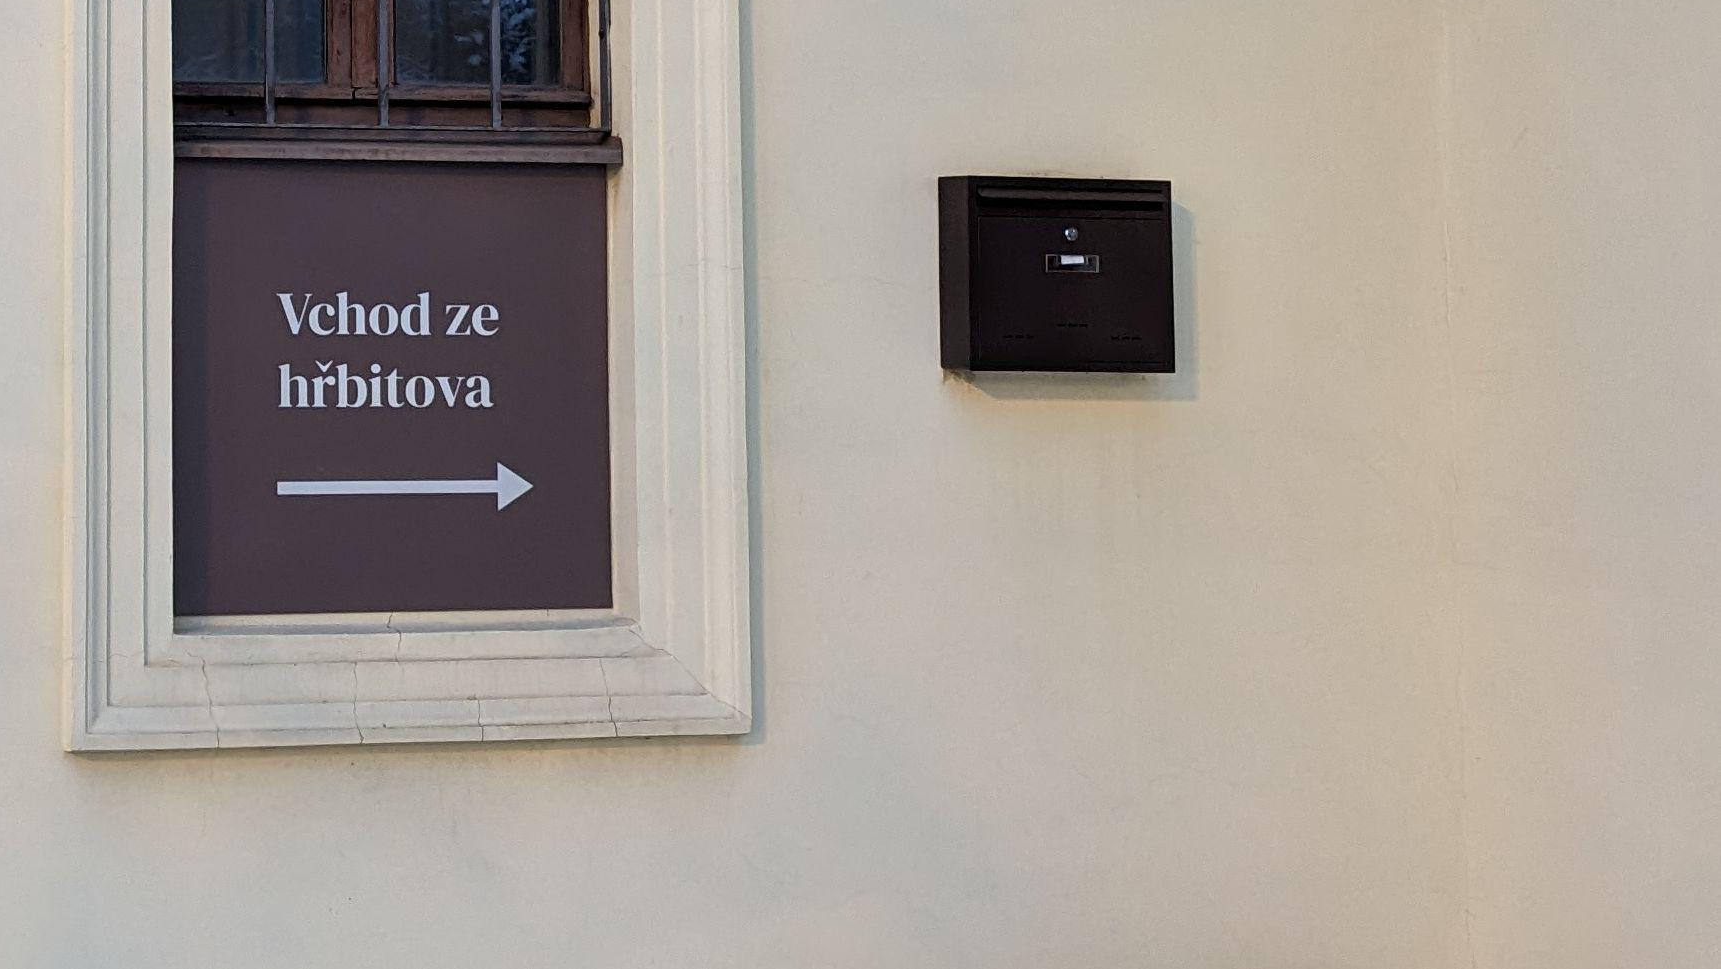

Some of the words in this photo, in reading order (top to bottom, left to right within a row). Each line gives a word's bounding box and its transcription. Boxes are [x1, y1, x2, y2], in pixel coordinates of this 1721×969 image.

[276, 291, 433, 336] Vchod
[445, 304, 499, 336] ze
[278, 360, 494, 408] hřbitova
